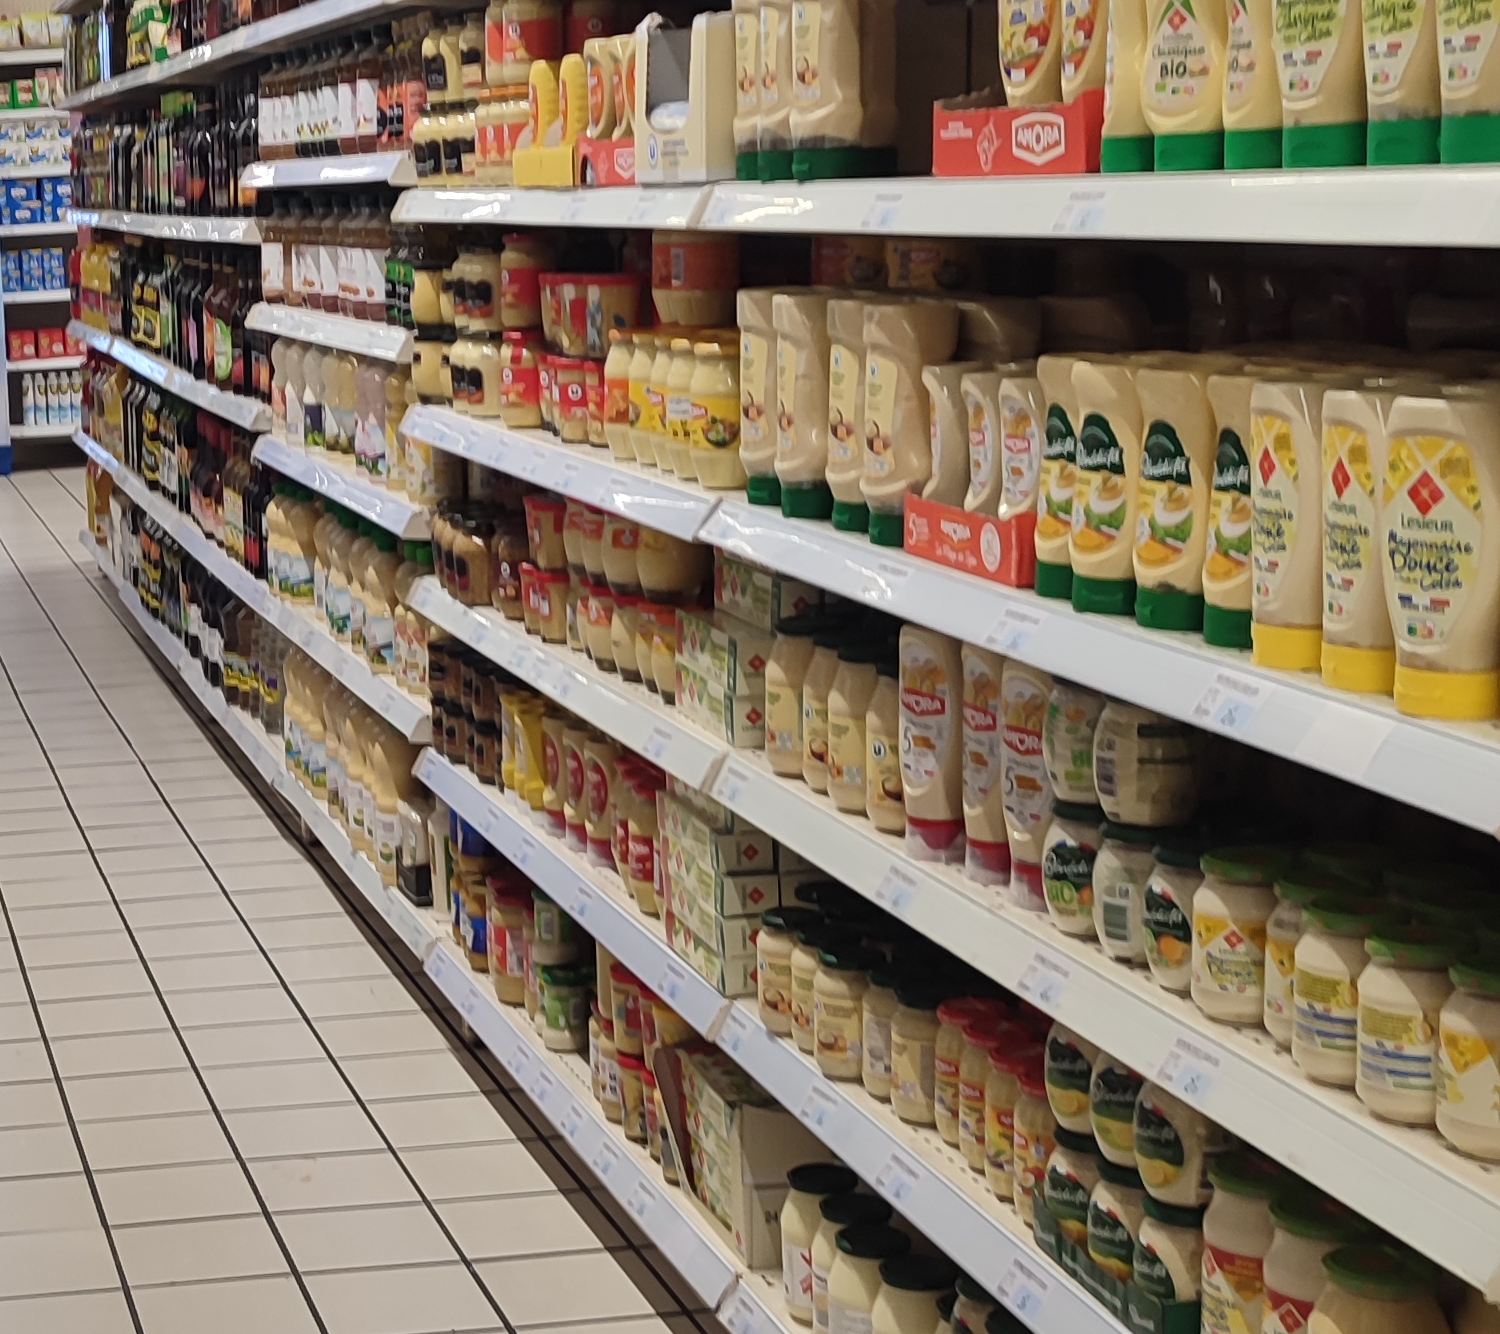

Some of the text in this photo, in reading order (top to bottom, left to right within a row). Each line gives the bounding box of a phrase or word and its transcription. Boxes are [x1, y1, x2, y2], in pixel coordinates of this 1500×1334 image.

[1160, 61, 1188, 79] BIO
[1017, 125, 1059, 153] AMORA
[1401, 513, 1453, 534] Lesieur
[1390, 548, 1460, 575] Douce
